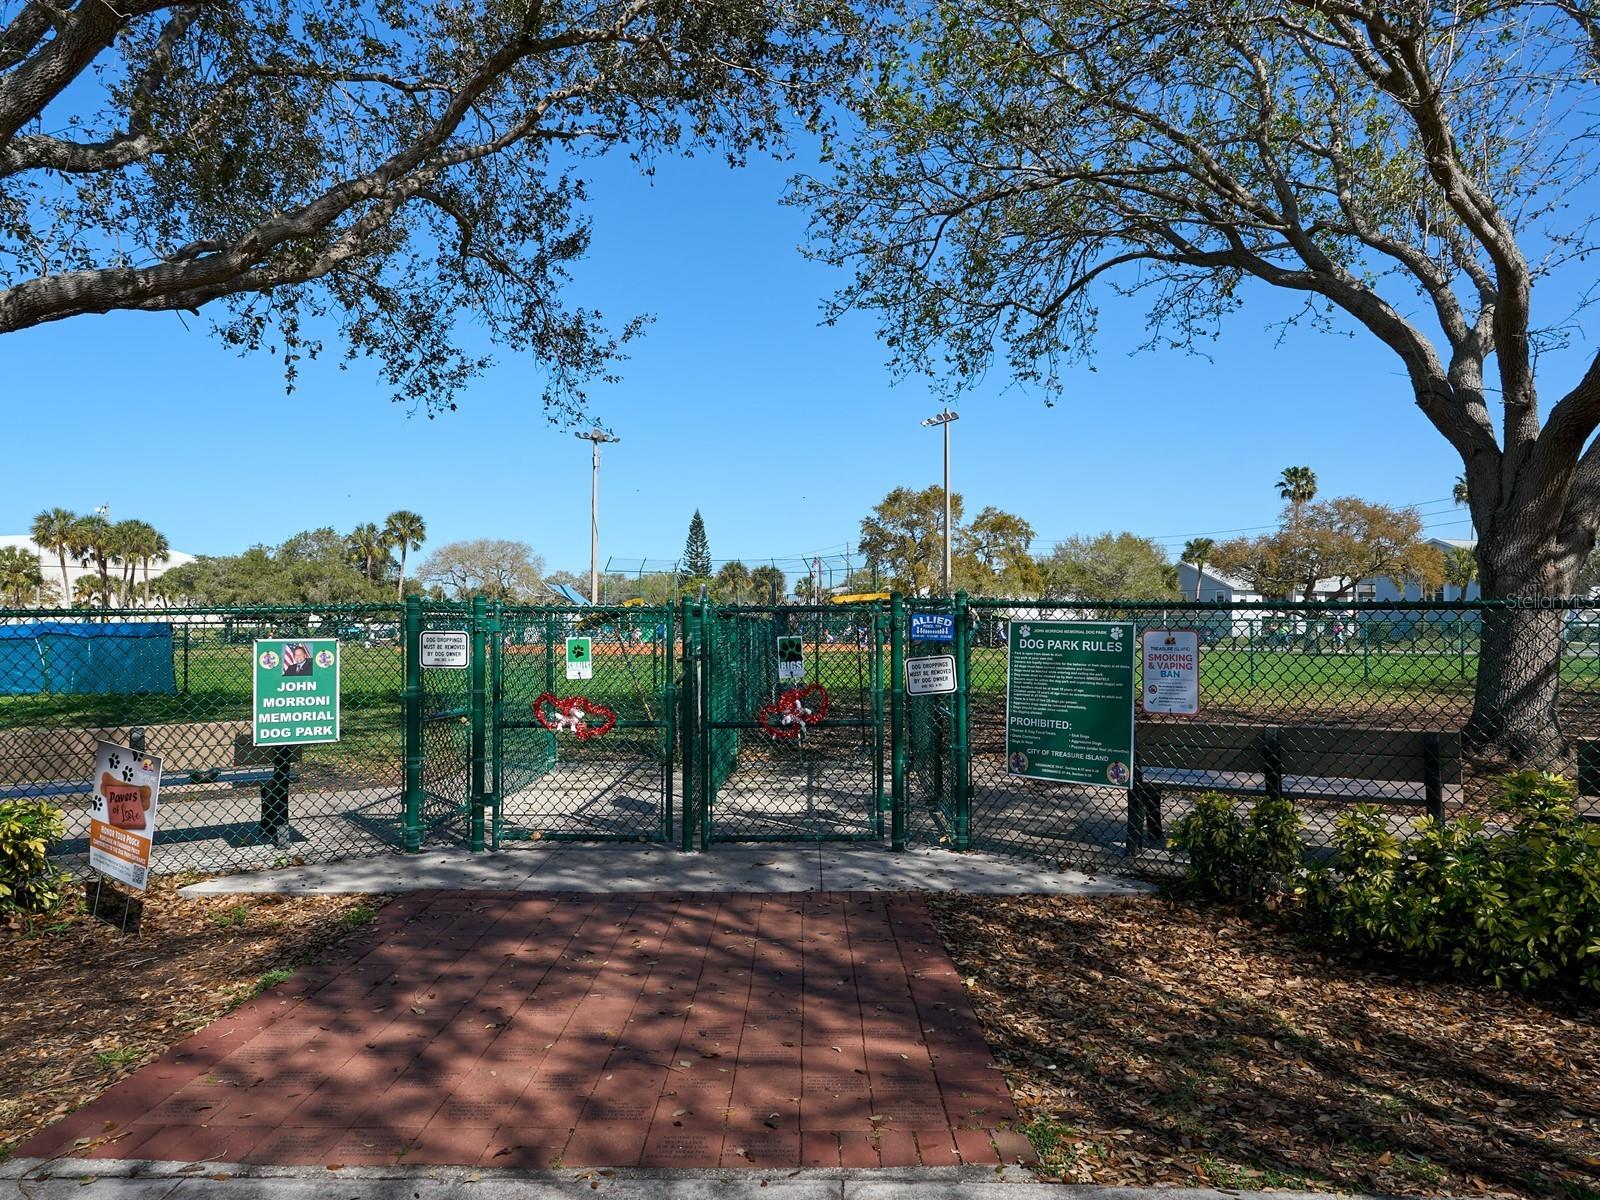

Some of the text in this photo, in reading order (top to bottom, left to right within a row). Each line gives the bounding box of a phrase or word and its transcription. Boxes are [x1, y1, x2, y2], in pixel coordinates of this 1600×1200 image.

[912, 616, 952, 626] ALLIED
[1019, 639, 1122, 652] DOG PARK RULES
[781, 660, 802, 670] BIGS
[277, 682, 316, 692] JOHN
[263, 696, 330, 707] MORRONI
[258, 711, 334, 723] MEMORIAL
[1010, 716, 1072, 730] PROHIBITED:
[260, 726, 332, 738] DOG PARK
[1051, 750, 1084, 759] TREASURE
[1085, 752, 1109, 761] ISLAND
[110, 791, 138, 803] Pavers
[112, 806, 119, 815] of
[102, 826, 114, 837] HONOR
[115, 830, 126, 842] YOUR
